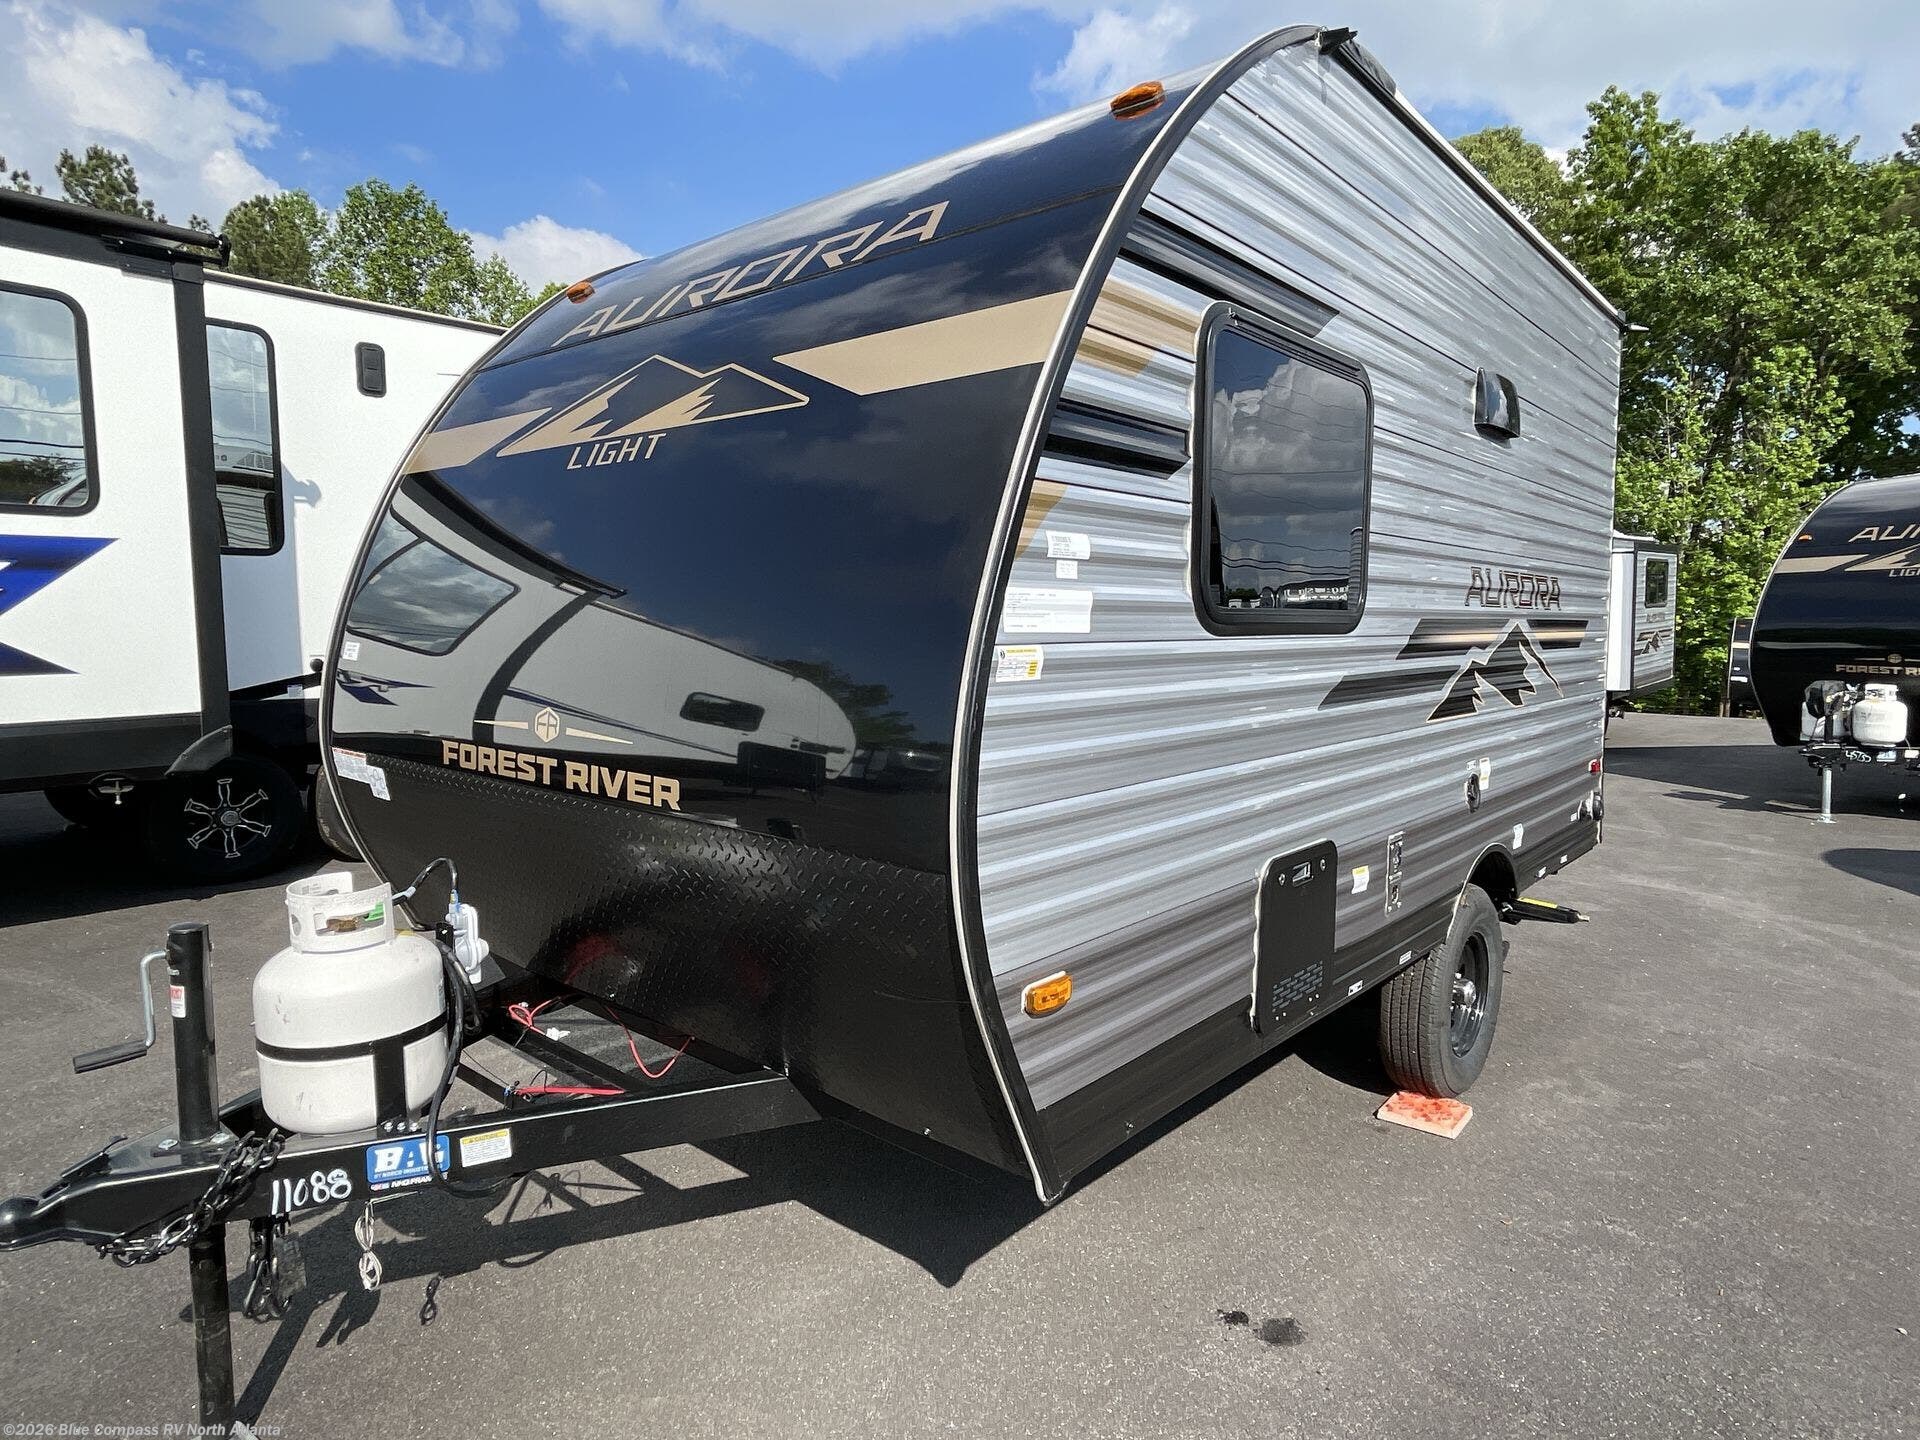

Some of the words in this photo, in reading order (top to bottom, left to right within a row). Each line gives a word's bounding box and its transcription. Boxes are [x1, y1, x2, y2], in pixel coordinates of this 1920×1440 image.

[551, 200, 950, 348] AURORA
[566, 432, 667, 470] LIGHT
[1464, 566, 1561, 611] AURORA
[1835, 664, 1904, 675] FOREST
[441, 739, 558, 785] FOREST
[564, 760, 681, 811] RIVER
[271, 1168, 352, 1215] 11088
